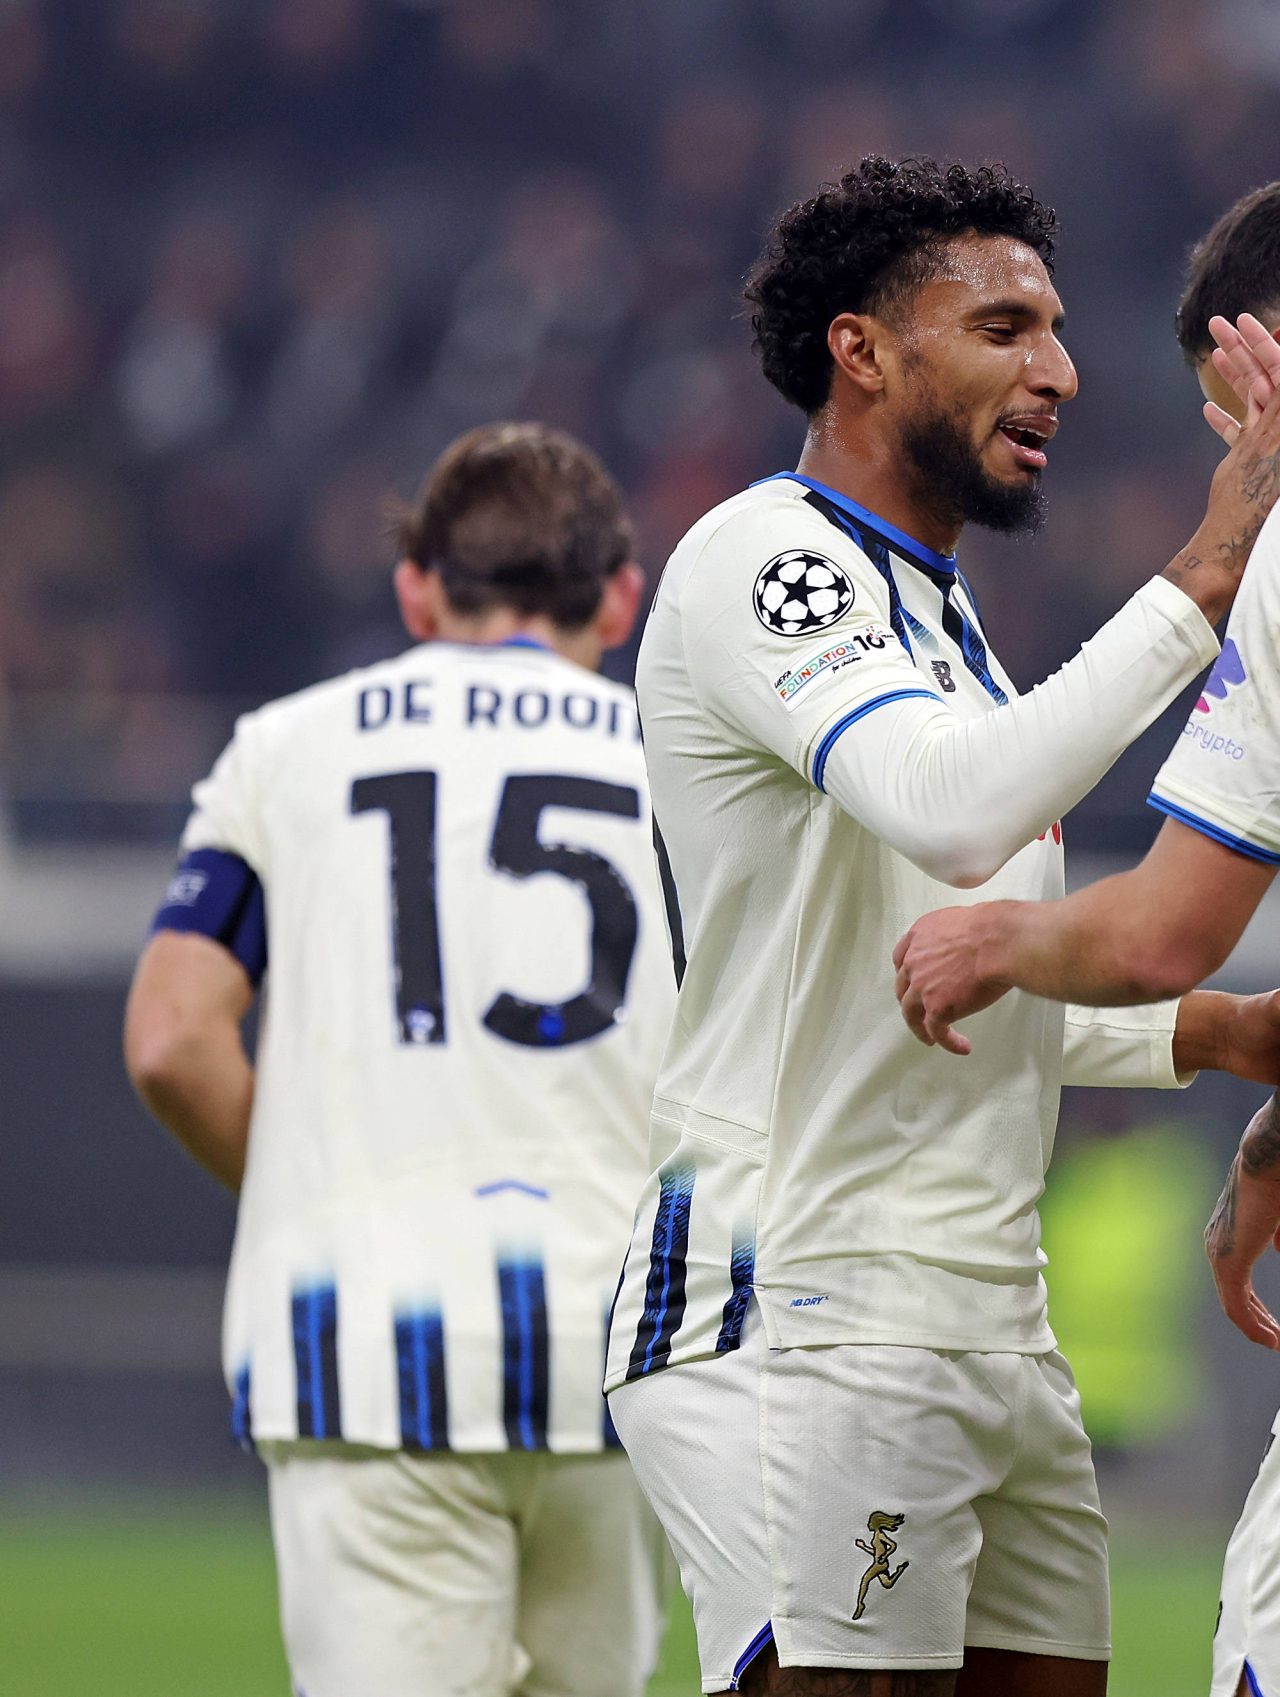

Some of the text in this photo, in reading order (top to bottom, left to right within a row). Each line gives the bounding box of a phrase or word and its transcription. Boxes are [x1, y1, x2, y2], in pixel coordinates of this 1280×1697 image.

[774, 670, 792, 689] UEFA
[779, 642, 856, 699] FOUNDATION
[359, 681, 431, 731] DE
[350, 771, 640, 1048] 15
